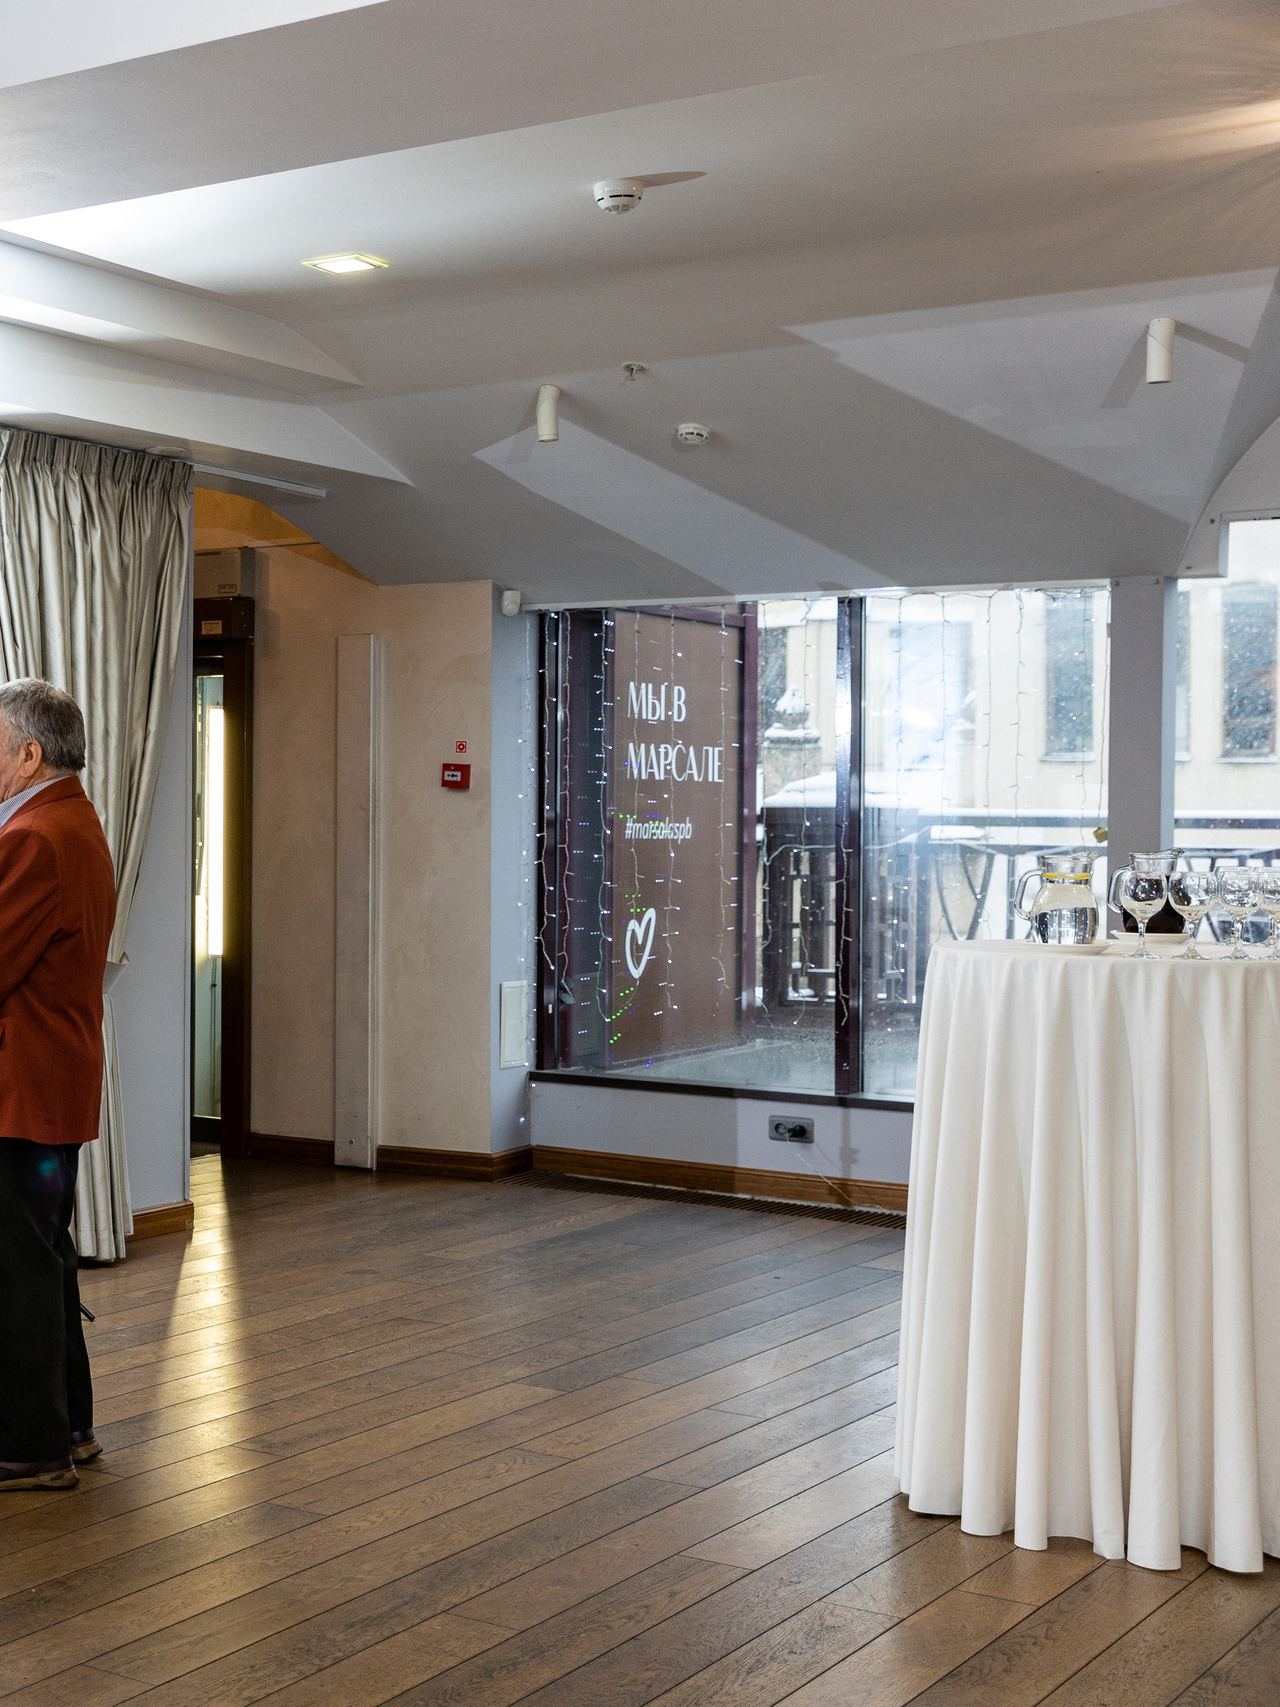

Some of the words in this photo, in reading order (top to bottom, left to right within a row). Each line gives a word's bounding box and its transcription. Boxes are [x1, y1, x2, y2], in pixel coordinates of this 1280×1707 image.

[627, 681, 666, 721] МЫ
[673, 685, 687, 722] В
[627, 742, 724, 782] МАРСАЛЕ
